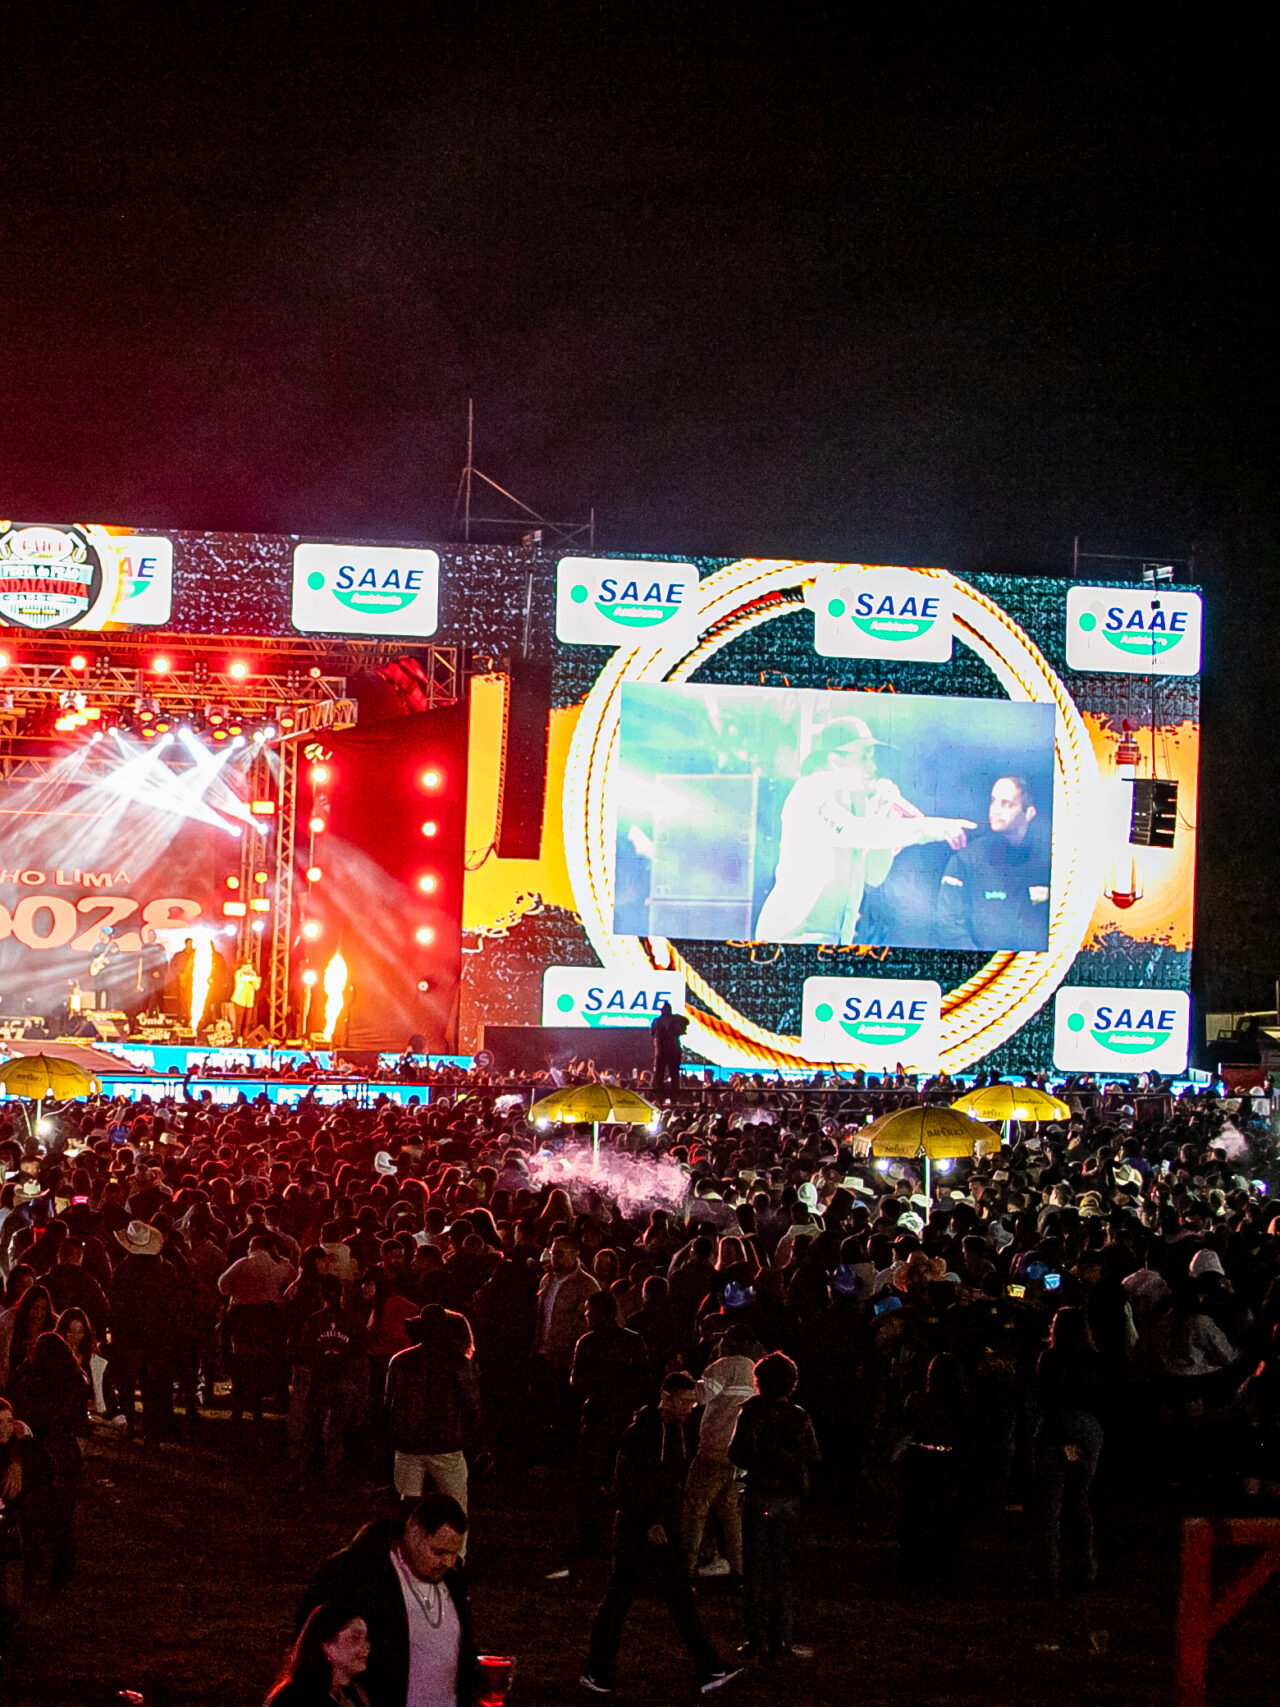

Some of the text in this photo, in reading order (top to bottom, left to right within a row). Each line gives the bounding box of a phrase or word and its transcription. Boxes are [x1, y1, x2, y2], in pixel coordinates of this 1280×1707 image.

[335, 565, 423, 590] SAAE
[598, 578, 685, 604] SAAE
[855, 592, 940, 618] SAAE
[1105, 607, 1188, 632] SAAE
[56, 868, 131, 888] LIMA
[585, 987, 671, 1011] SAAE
[842, 997, 927, 1022] SAAE
[1093, 1006, 1177, 1031] SAAE
